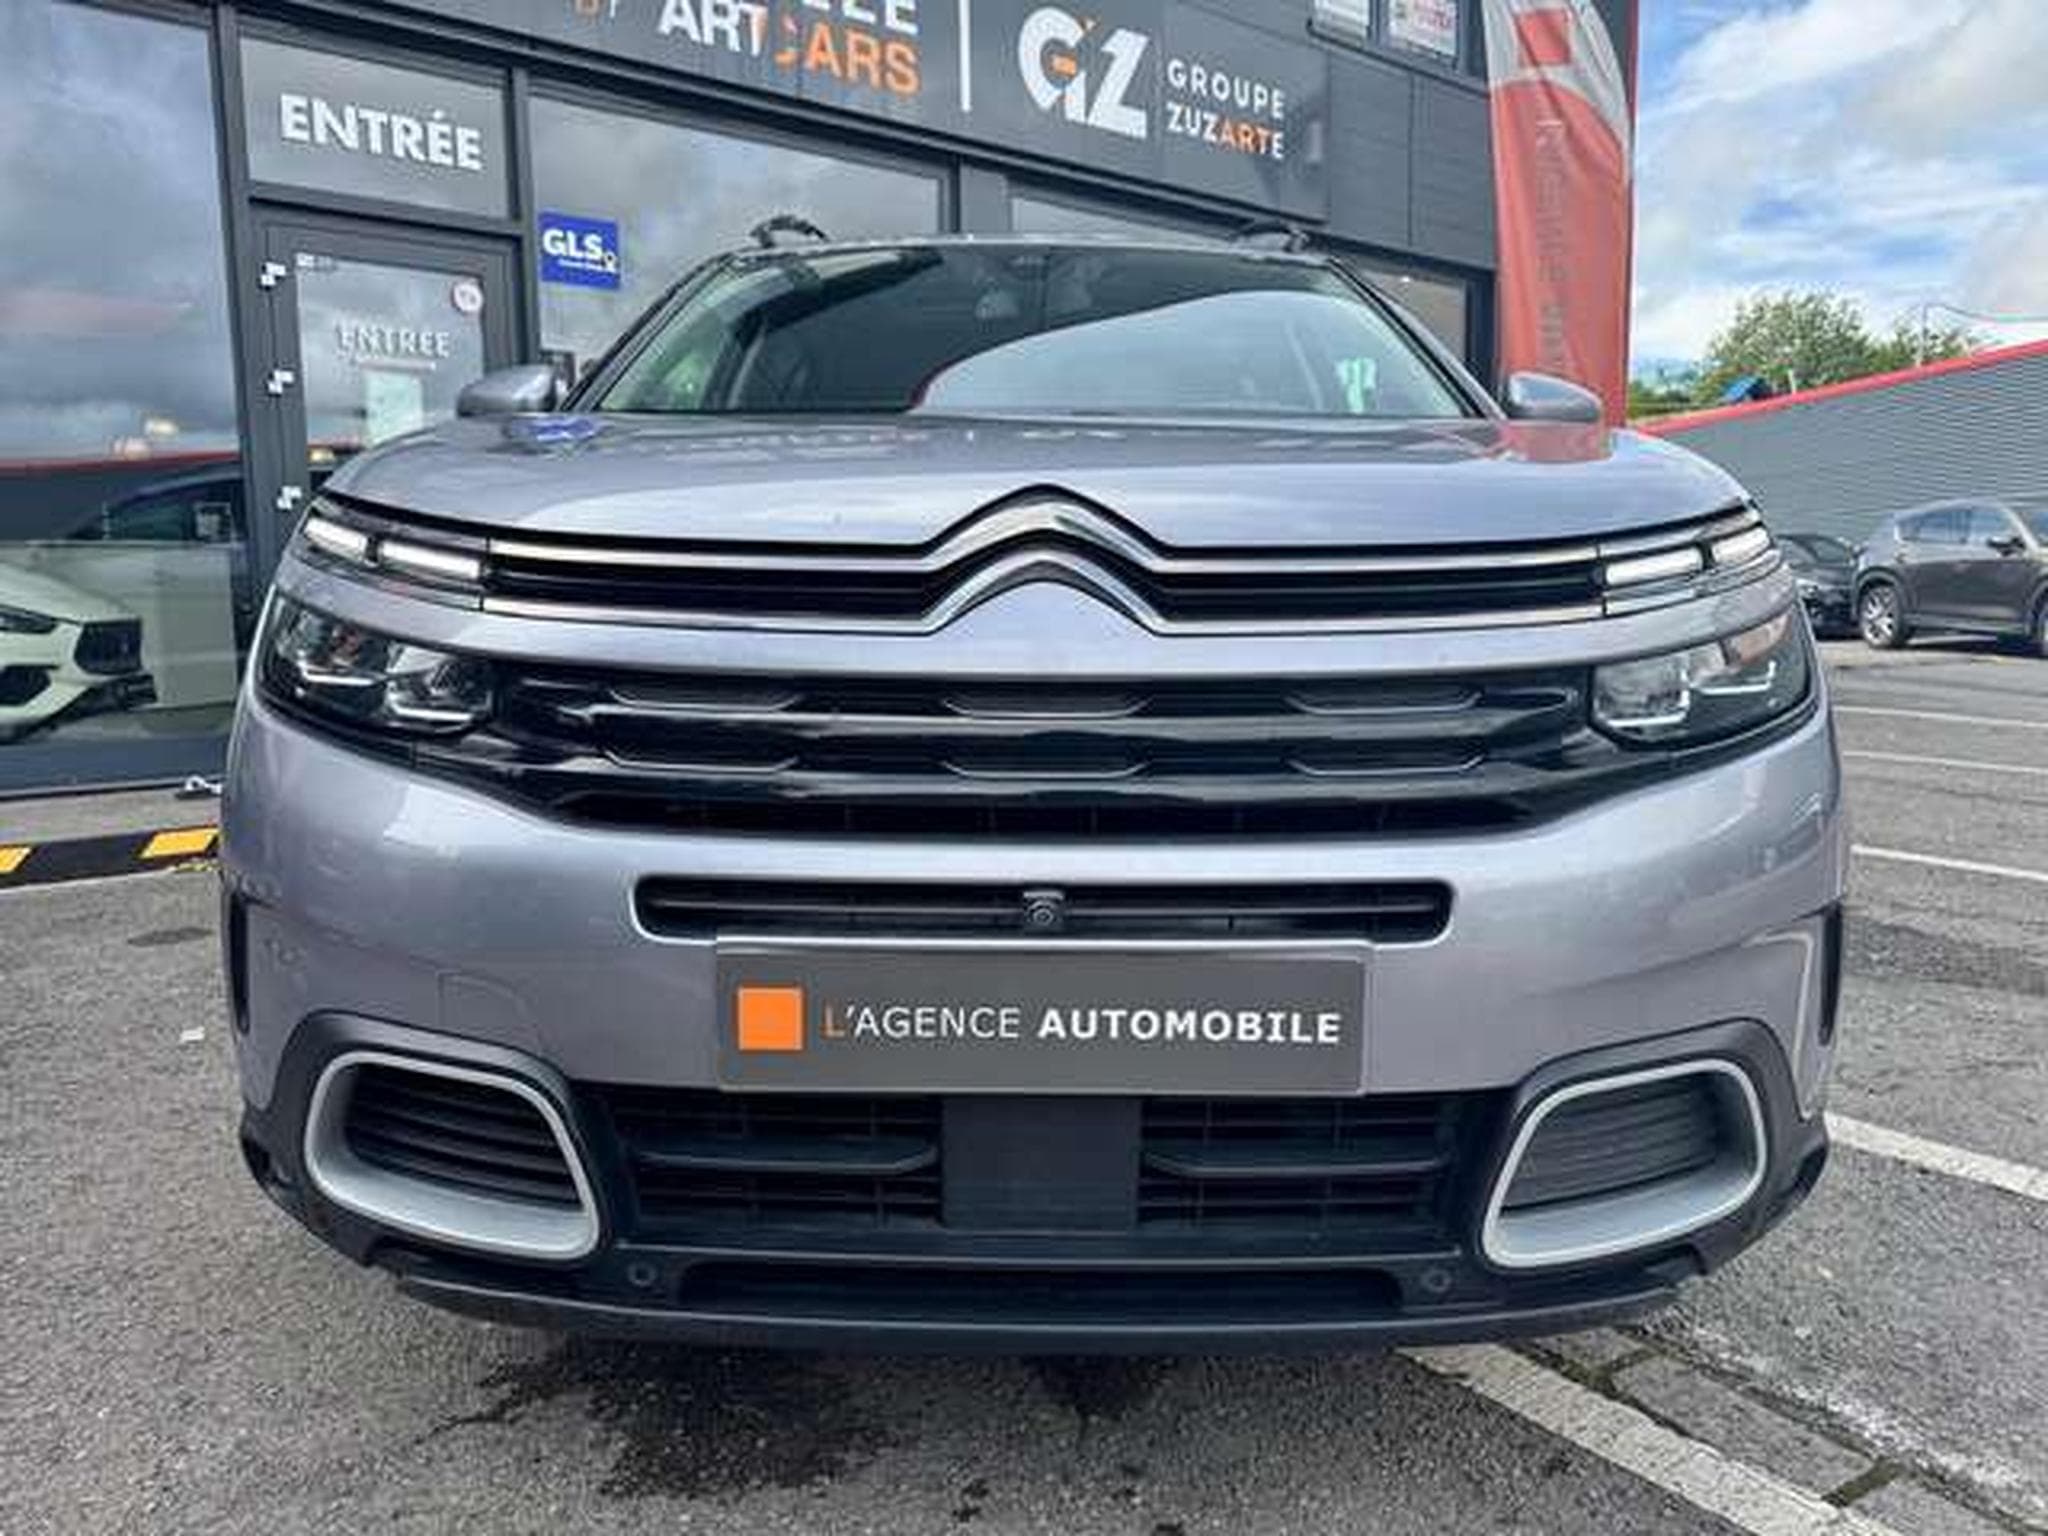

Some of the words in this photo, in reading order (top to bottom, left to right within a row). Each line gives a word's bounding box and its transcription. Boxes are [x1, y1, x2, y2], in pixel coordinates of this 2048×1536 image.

[1167, 58, 1286, 119] GROUPE
[281, 93, 483, 171] ENTRÉE
[1166, 101, 1286, 160] ZUZARTE
[543, 228, 603, 261] GLS
[824, 1004, 1021, 1038] L'AGENCE
[1037, 1006, 1342, 1043] AUTOMOBILE
